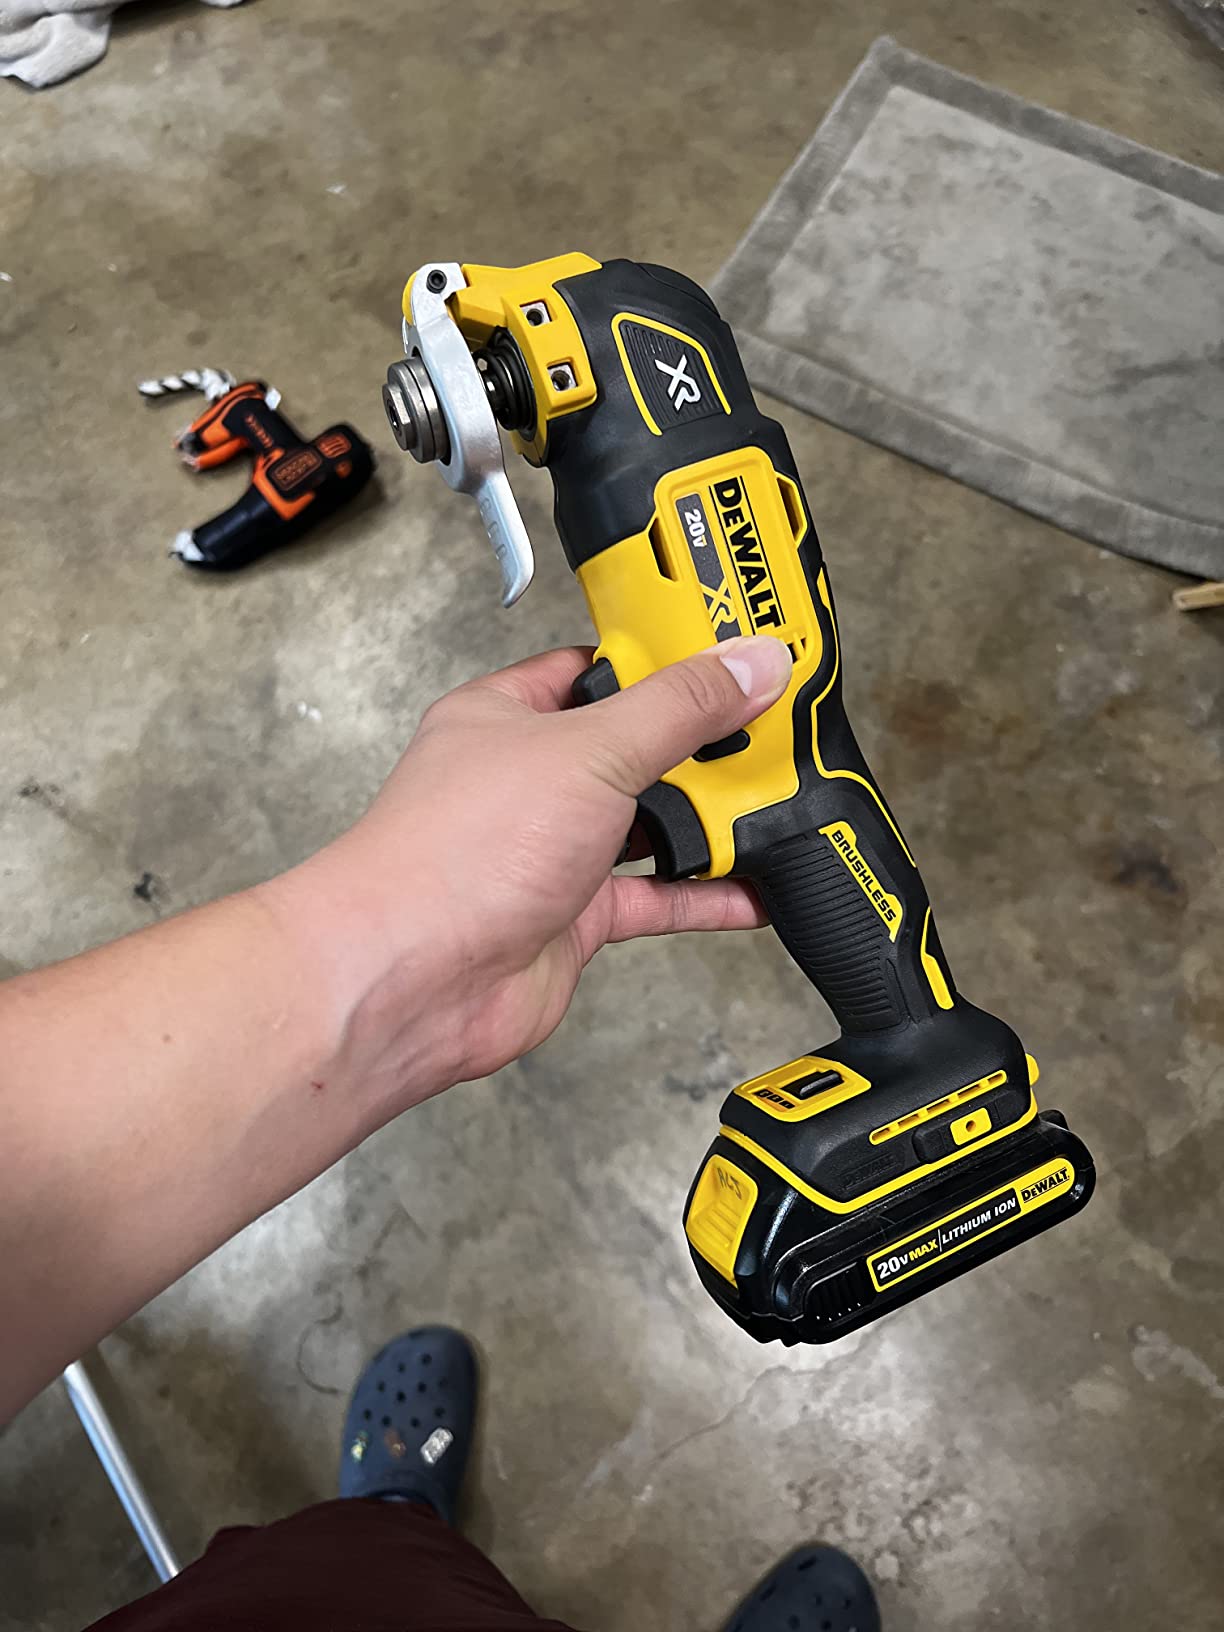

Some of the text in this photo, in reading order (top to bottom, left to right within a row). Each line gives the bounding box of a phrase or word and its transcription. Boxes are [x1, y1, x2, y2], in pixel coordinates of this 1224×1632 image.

[655, 354, 701, 411] XR
[684, 508, 737, 633] 20V XR
[713, 477, 782, 629] DEWALT
[832, 830, 896, 922] BRUSHLESS
[942, 1211, 991, 1244] LITHIUM
[995, 1197, 1016, 1217] ION
[1021, 1168, 1069, 1202] DEWALT
